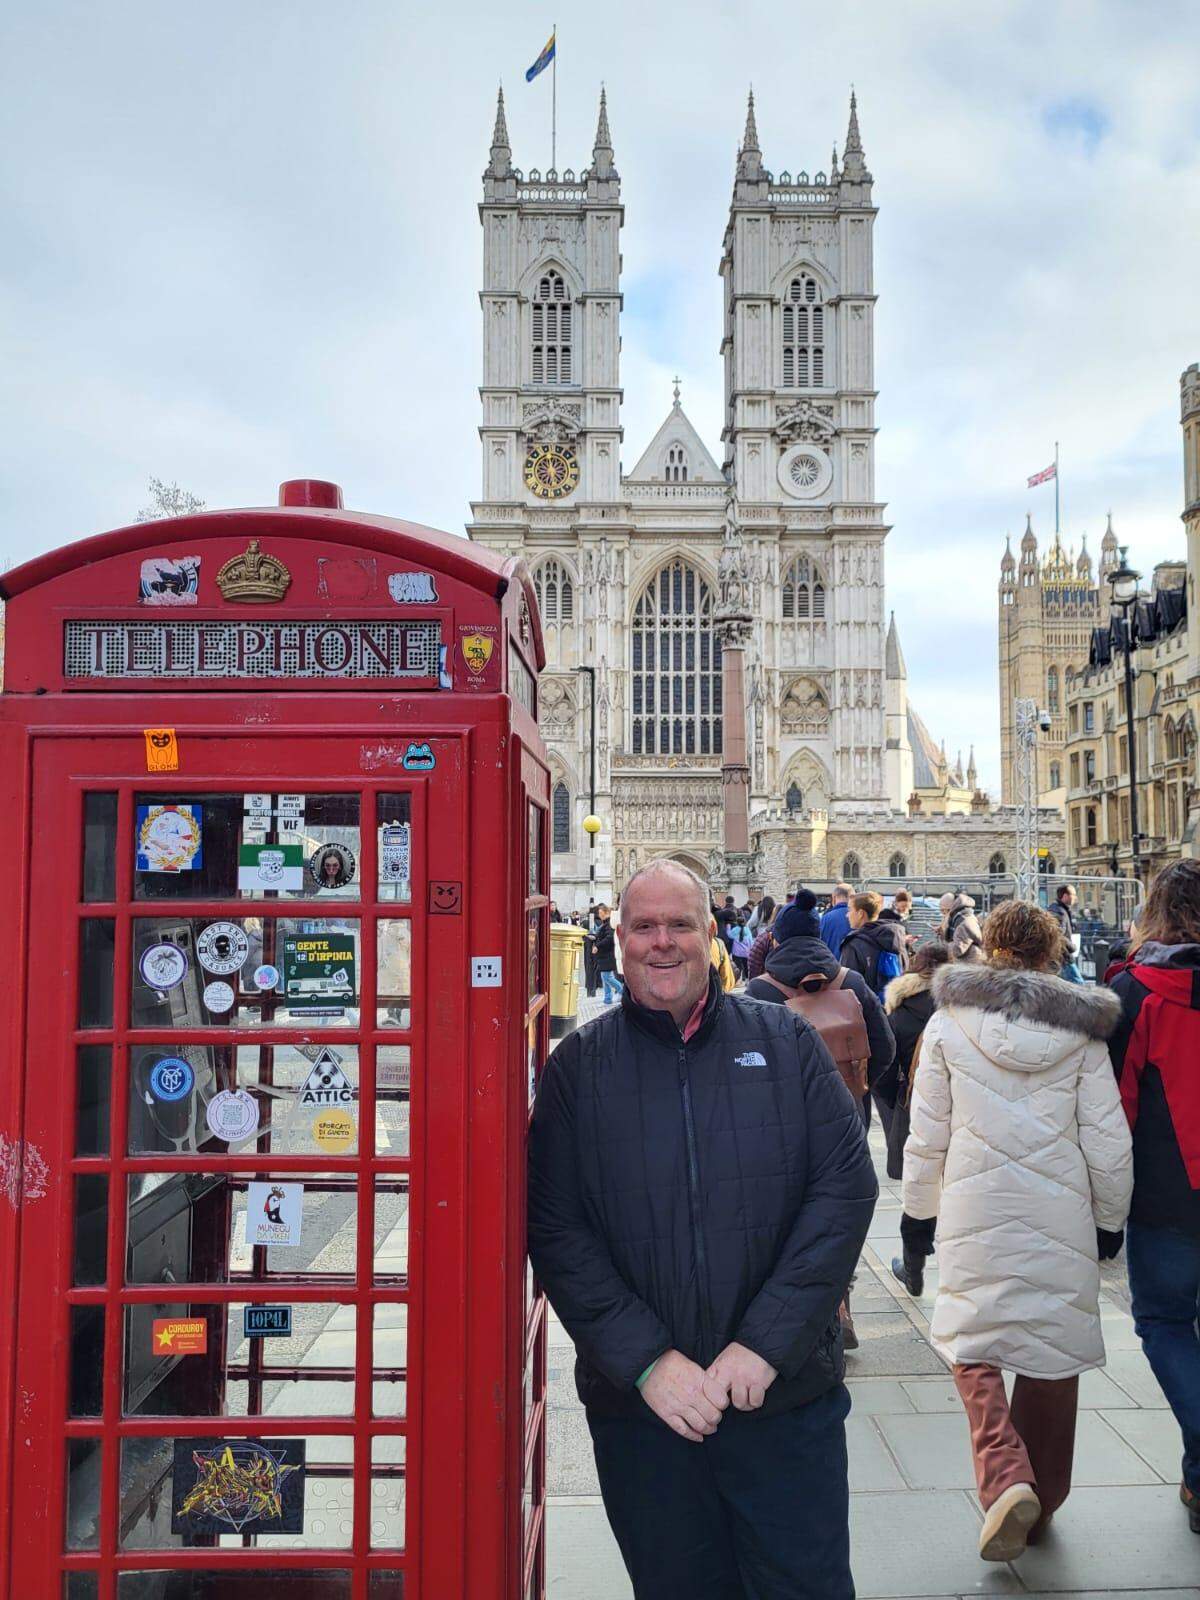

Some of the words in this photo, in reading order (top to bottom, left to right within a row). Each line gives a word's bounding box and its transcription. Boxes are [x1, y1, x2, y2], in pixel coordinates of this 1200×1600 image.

[83, 628, 426, 673] TELEPHONE
[467, 676, 486, 684] ROMA
[283, 820, 298, 831] VLF
[200, 926, 222, 944] EAST
[228, 926, 244, 942] END
[286, 943, 296, 951] 19
[297, 941, 329, 951] GENTE
[297, 953, 306, 961] 12
[308, 951, 353, 962] D'IRPINIA
[302, 1089, 351, 1103] ATTIC
[168, 1323, 205, 1333] CORDUROY
